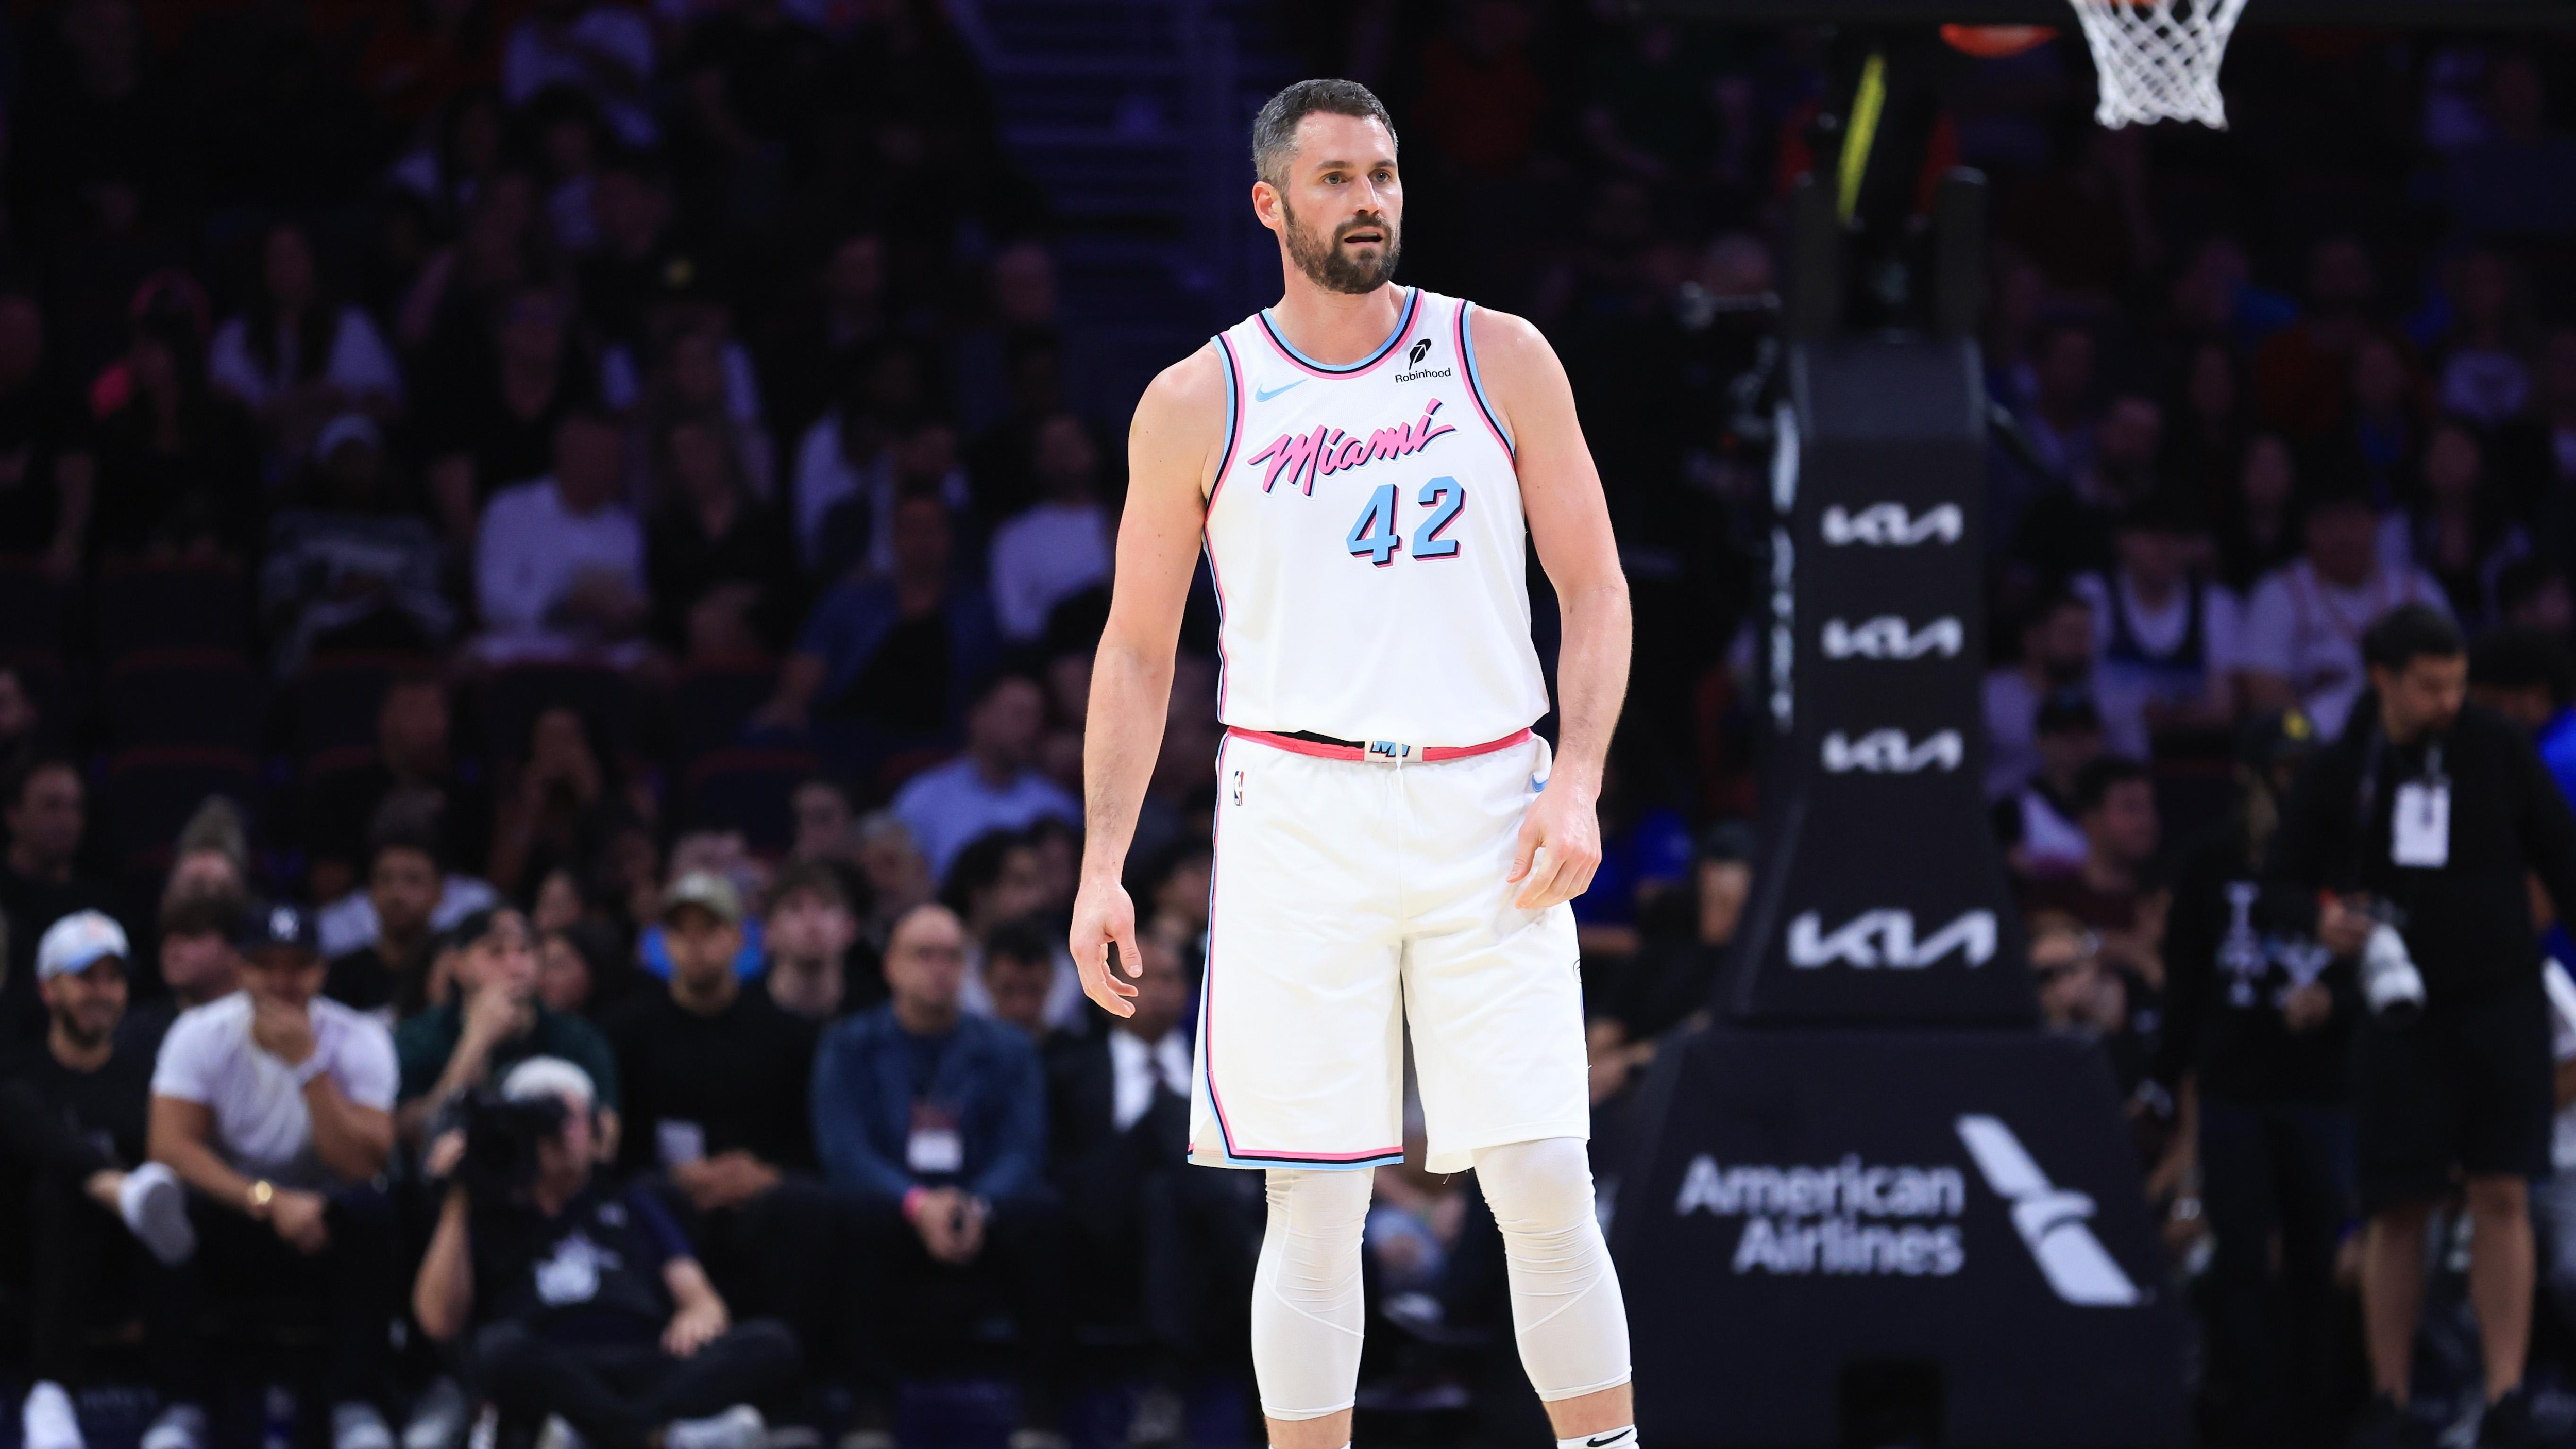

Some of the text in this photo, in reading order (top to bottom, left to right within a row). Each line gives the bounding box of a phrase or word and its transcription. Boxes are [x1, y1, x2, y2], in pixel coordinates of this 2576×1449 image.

[1395, 367, 1451, 383] Robinhood
[1247, 398, 1457, 497] Miami
[1346, 476, 1467, 568] 42
[1788, 909, 1997, 969] KIA
[1675, 1153, 1964, 1216] American
[1731, 1216, 1965, 1276] Airlines
